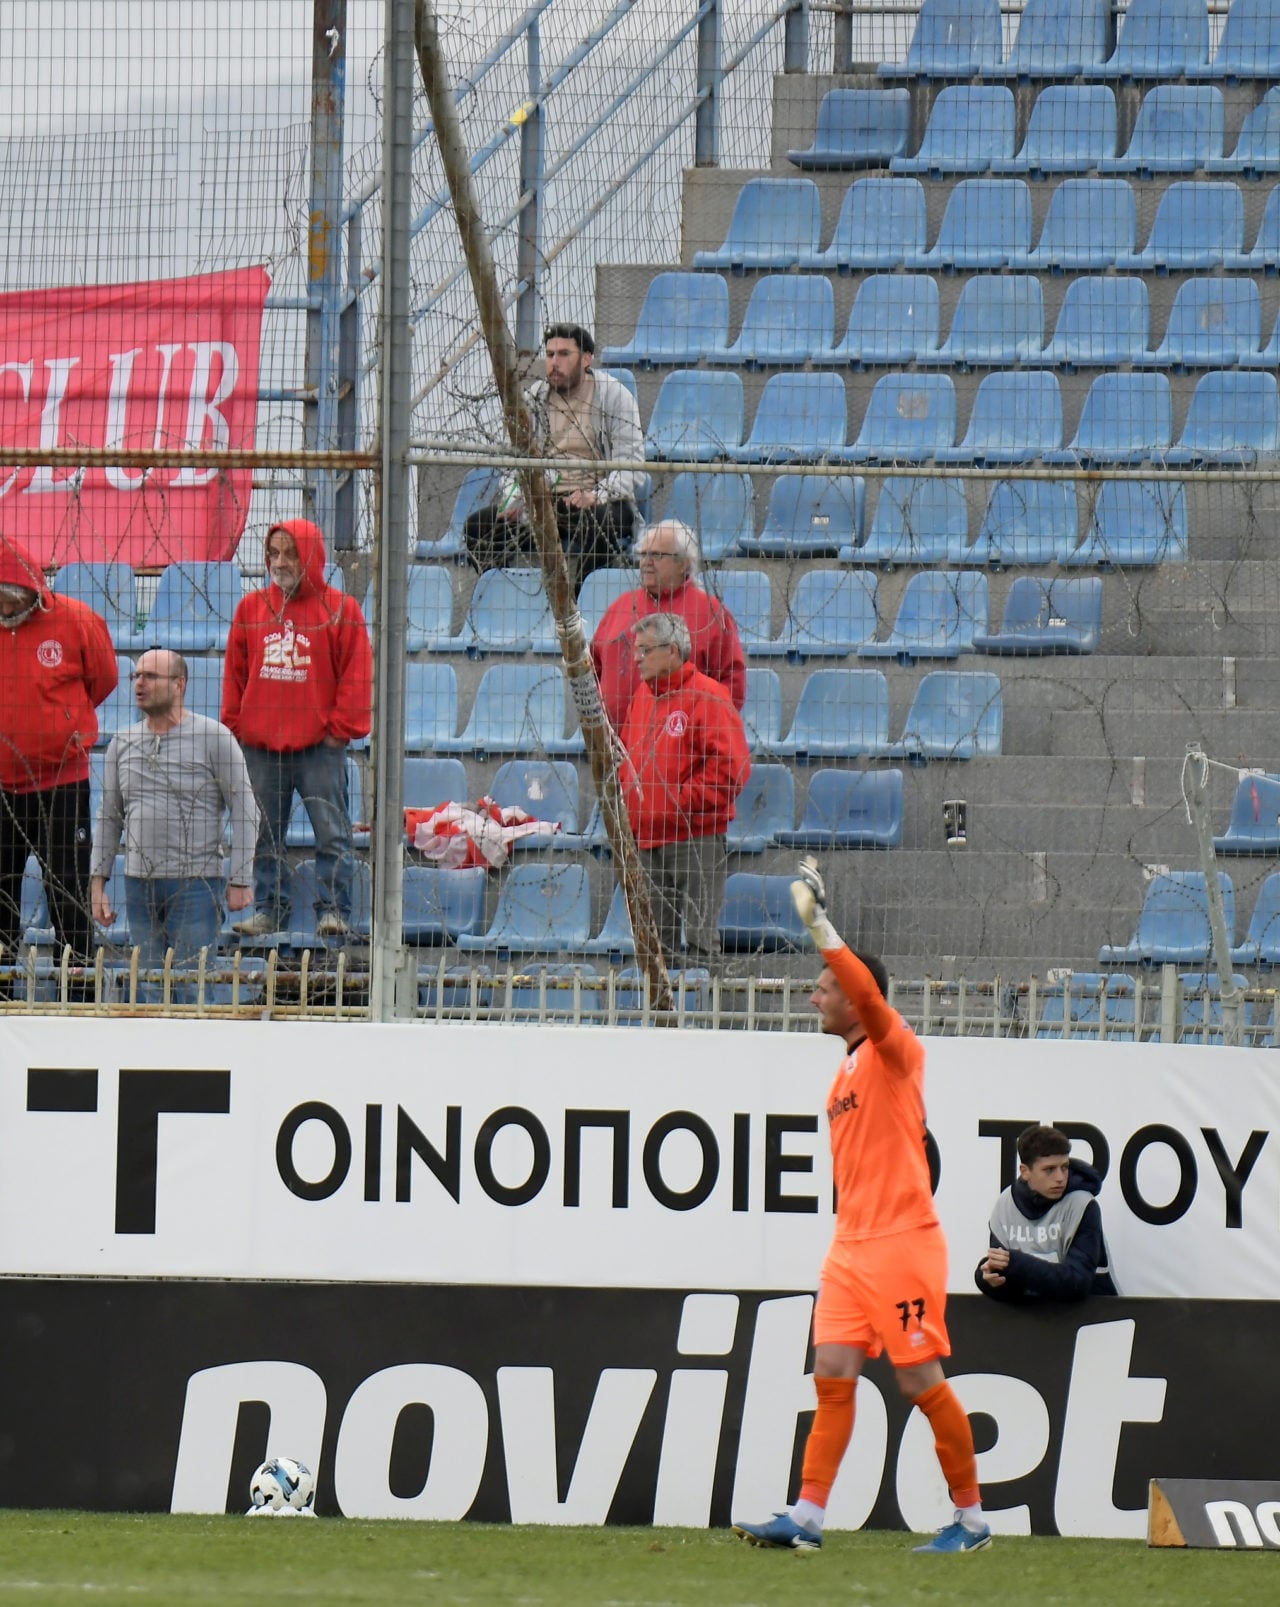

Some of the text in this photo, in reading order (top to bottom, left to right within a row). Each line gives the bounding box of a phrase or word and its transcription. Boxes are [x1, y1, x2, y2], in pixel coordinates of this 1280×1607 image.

[276, 1100, 942, 1214] ΟΙΝΟΠΟΙΕ
[895, 1297, 926, 1332] 77
[170, 1293, 1168, 1540] novibet
